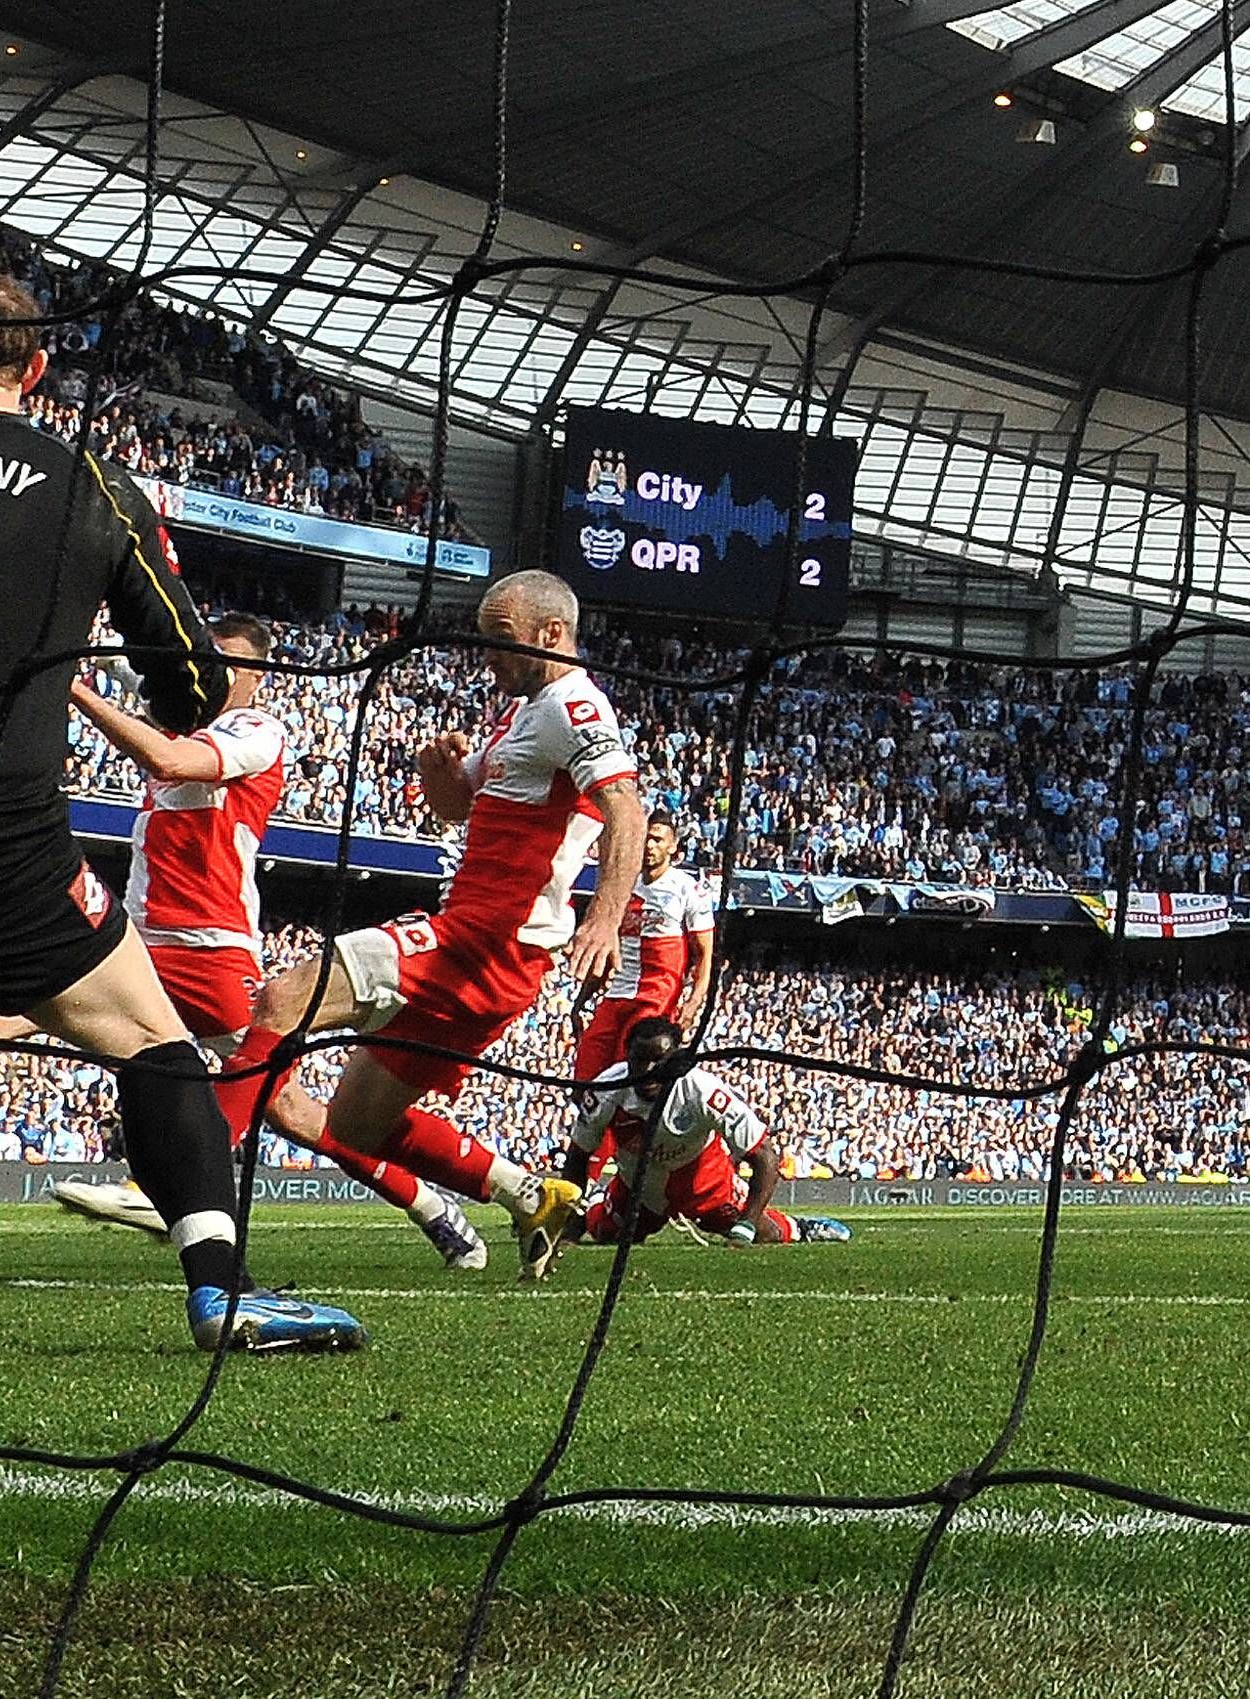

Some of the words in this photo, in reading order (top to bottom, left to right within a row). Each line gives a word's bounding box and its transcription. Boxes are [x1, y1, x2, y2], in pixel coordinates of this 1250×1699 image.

[637, 471, 702, 510] City
[804, 493, 825, 520] 2
[631, 539, 701, 573] QPR
[800, 559, 821, 586] 2
[849, 1186, 933, 1207] JAGAR
[948, 1188, 1041, 1205] DISCOVER
[1044, 1189, 1096, 1205] ORE
[1099, 1189, 1125, 1205] AT
